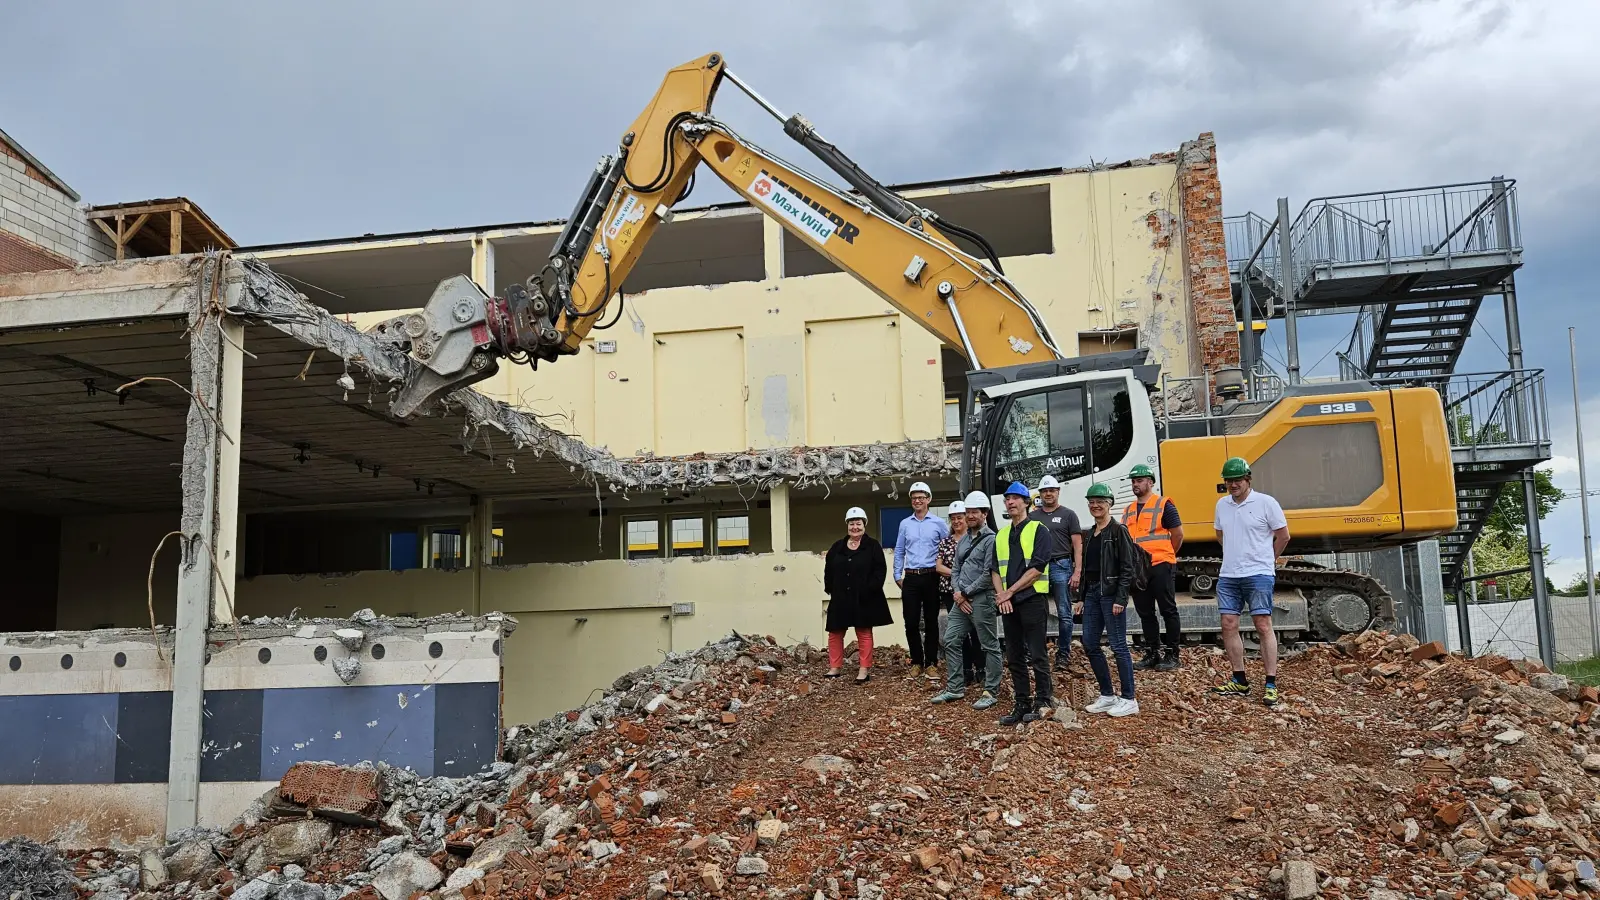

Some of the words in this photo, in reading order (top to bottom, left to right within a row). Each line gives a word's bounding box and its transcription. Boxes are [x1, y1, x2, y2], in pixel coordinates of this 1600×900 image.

[614, 213, 625, 226] Max
[771, 192, 800, 217] Max
[800, 211, 831, 238] Wild
[1320, 402, 1357, 414] 938
[1046, 454, 1085, 469] Arthur
[1343, 516, 1375, 524] 11920860
